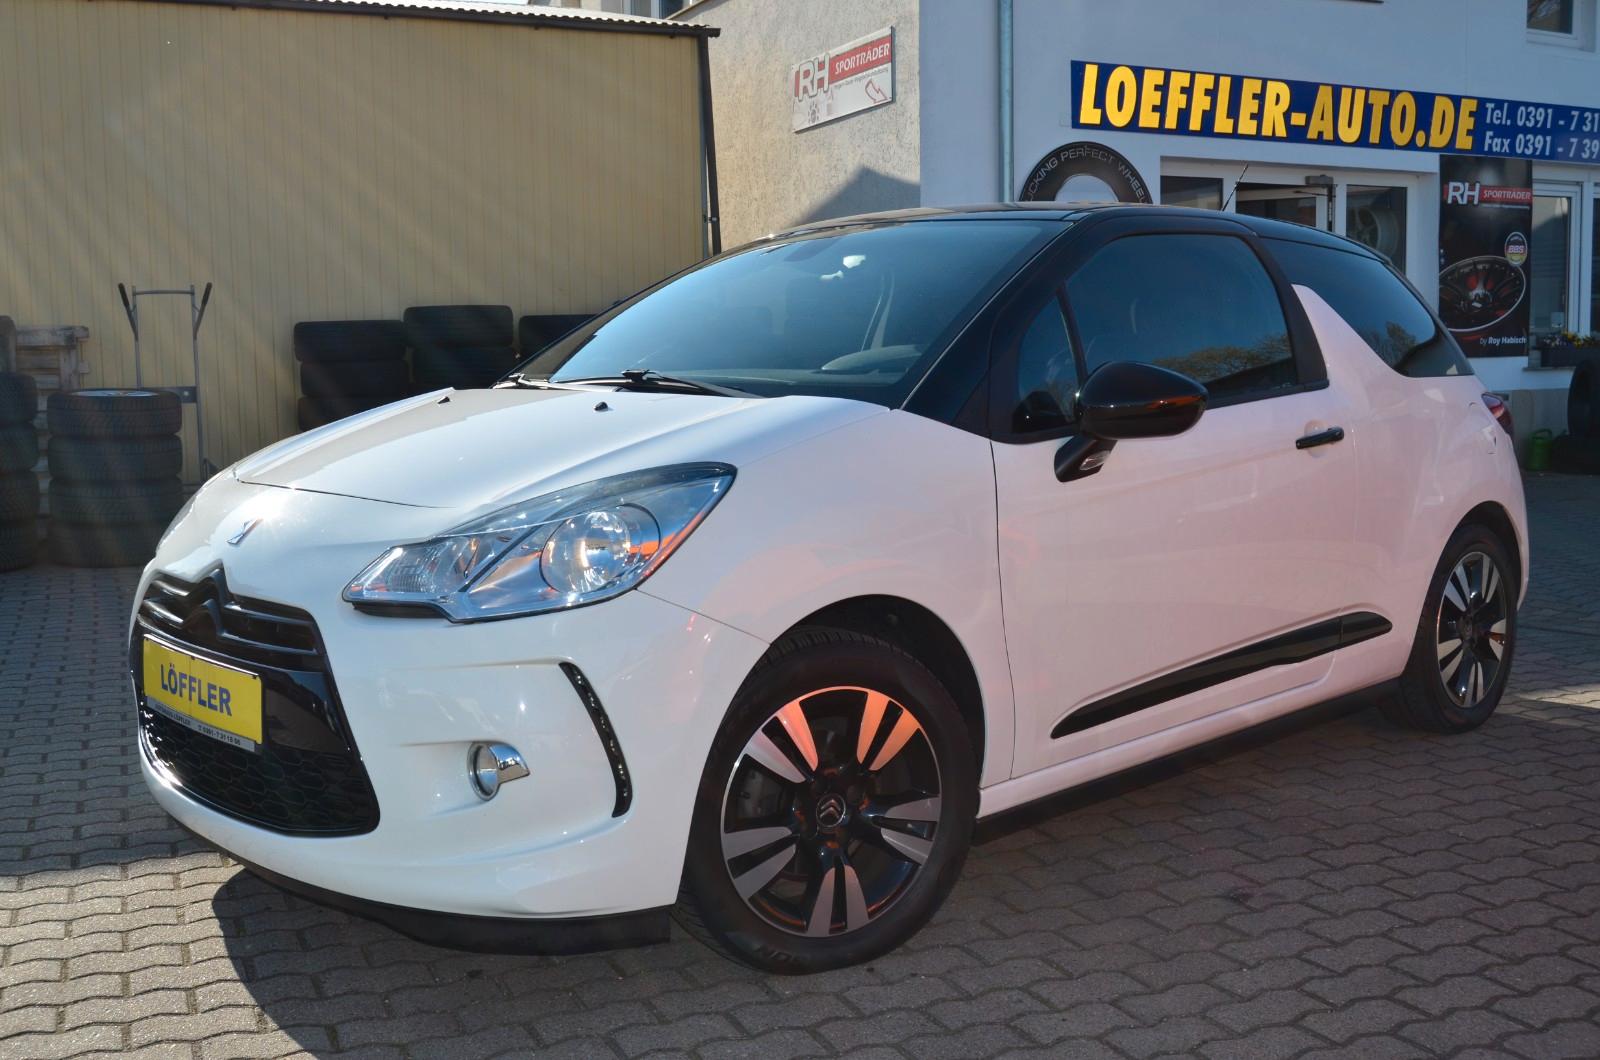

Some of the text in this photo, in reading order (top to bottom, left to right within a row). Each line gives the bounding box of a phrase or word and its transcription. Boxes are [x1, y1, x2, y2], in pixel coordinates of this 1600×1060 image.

[797, 51, 831, 102] RH
[1079, 63, 1478, 150] LOEFFLER-AUTO.DE
[1485, 102, 1511, 126] Tel.
[1516, 106, 1553, 129] 0391
[1483, 131, 1511, 153] Fax
[1515, 133, 1552, 156] 0391
[1447, 181, 1481, 205] RH
[160, 663, 233, 717] LÖFFLER
